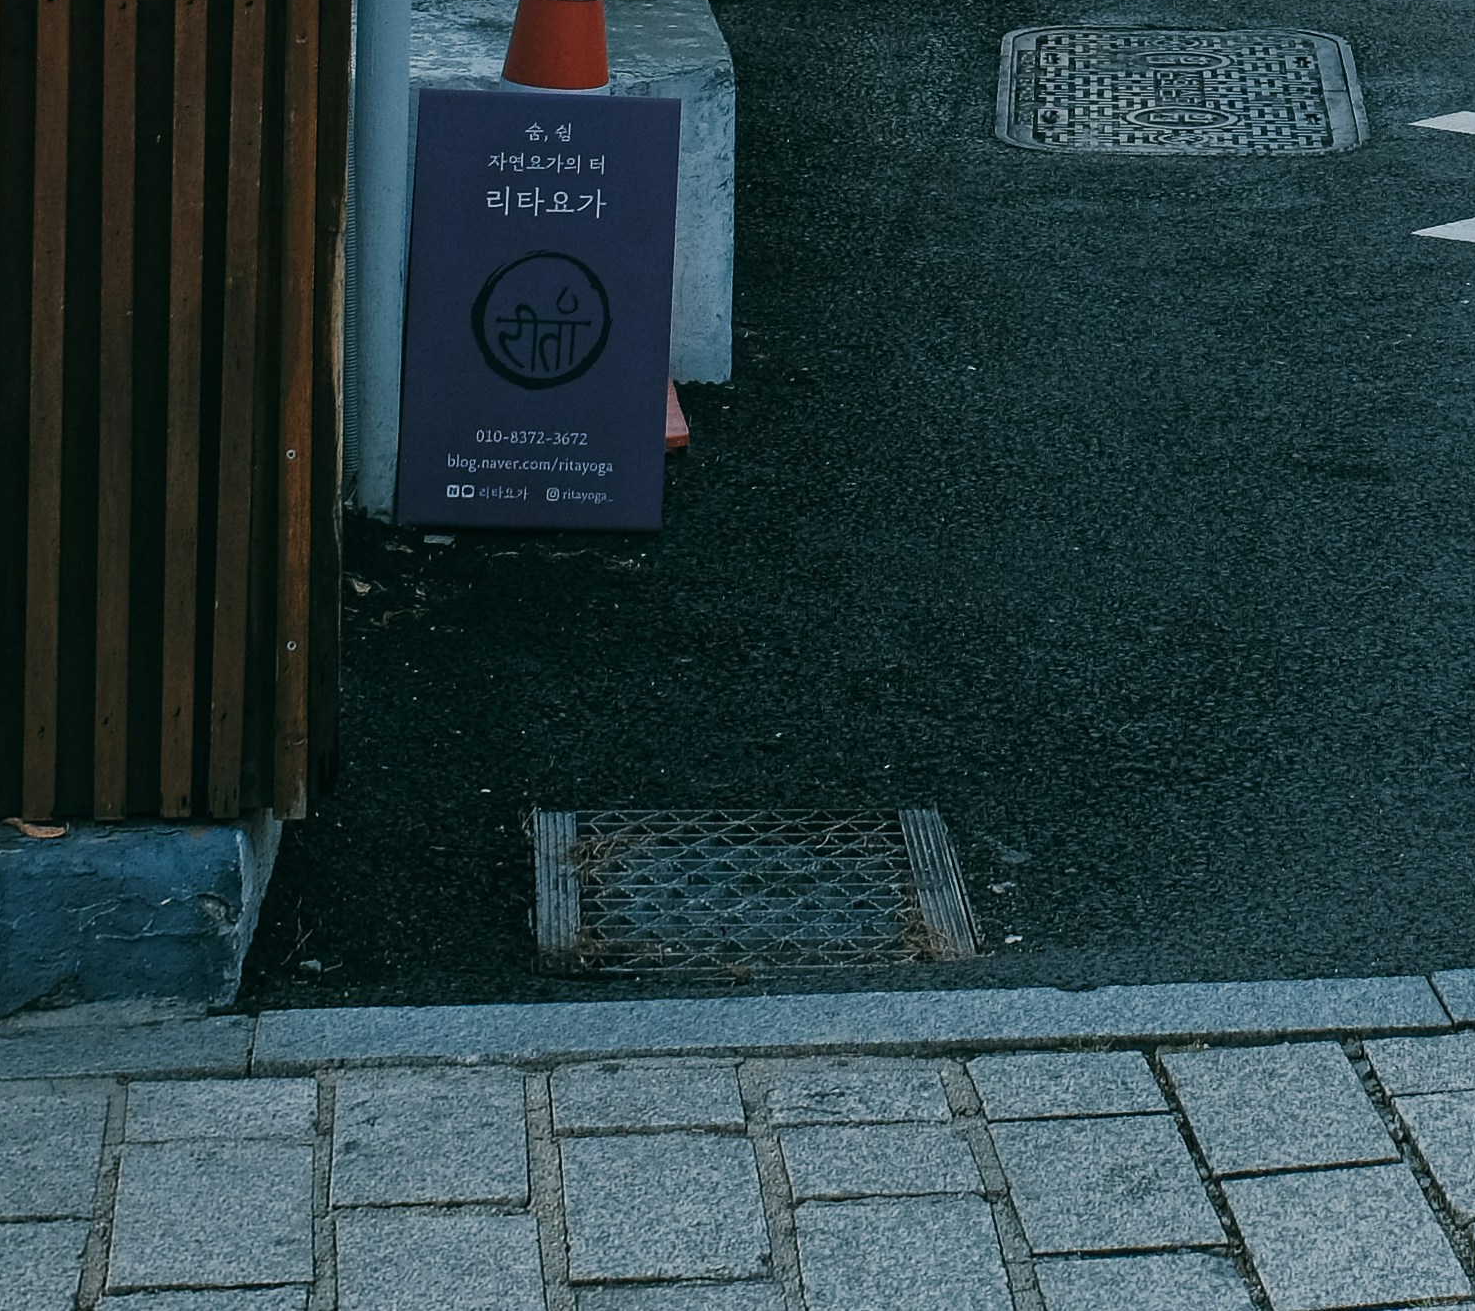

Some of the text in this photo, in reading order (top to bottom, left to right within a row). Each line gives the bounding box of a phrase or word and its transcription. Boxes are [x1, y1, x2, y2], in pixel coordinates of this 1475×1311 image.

[524, 121, 573, 144] 숨, 쉼
[487, 152, 606, 176] 자연요가의 터
[485, 186, 608, 220] 리타요가
[475, 427, 589, 448] 010-8372-3672
[446, 453, 615, 476] blog.naver.com/ritayoga
[478, 485, 530, 502] 리타요가
